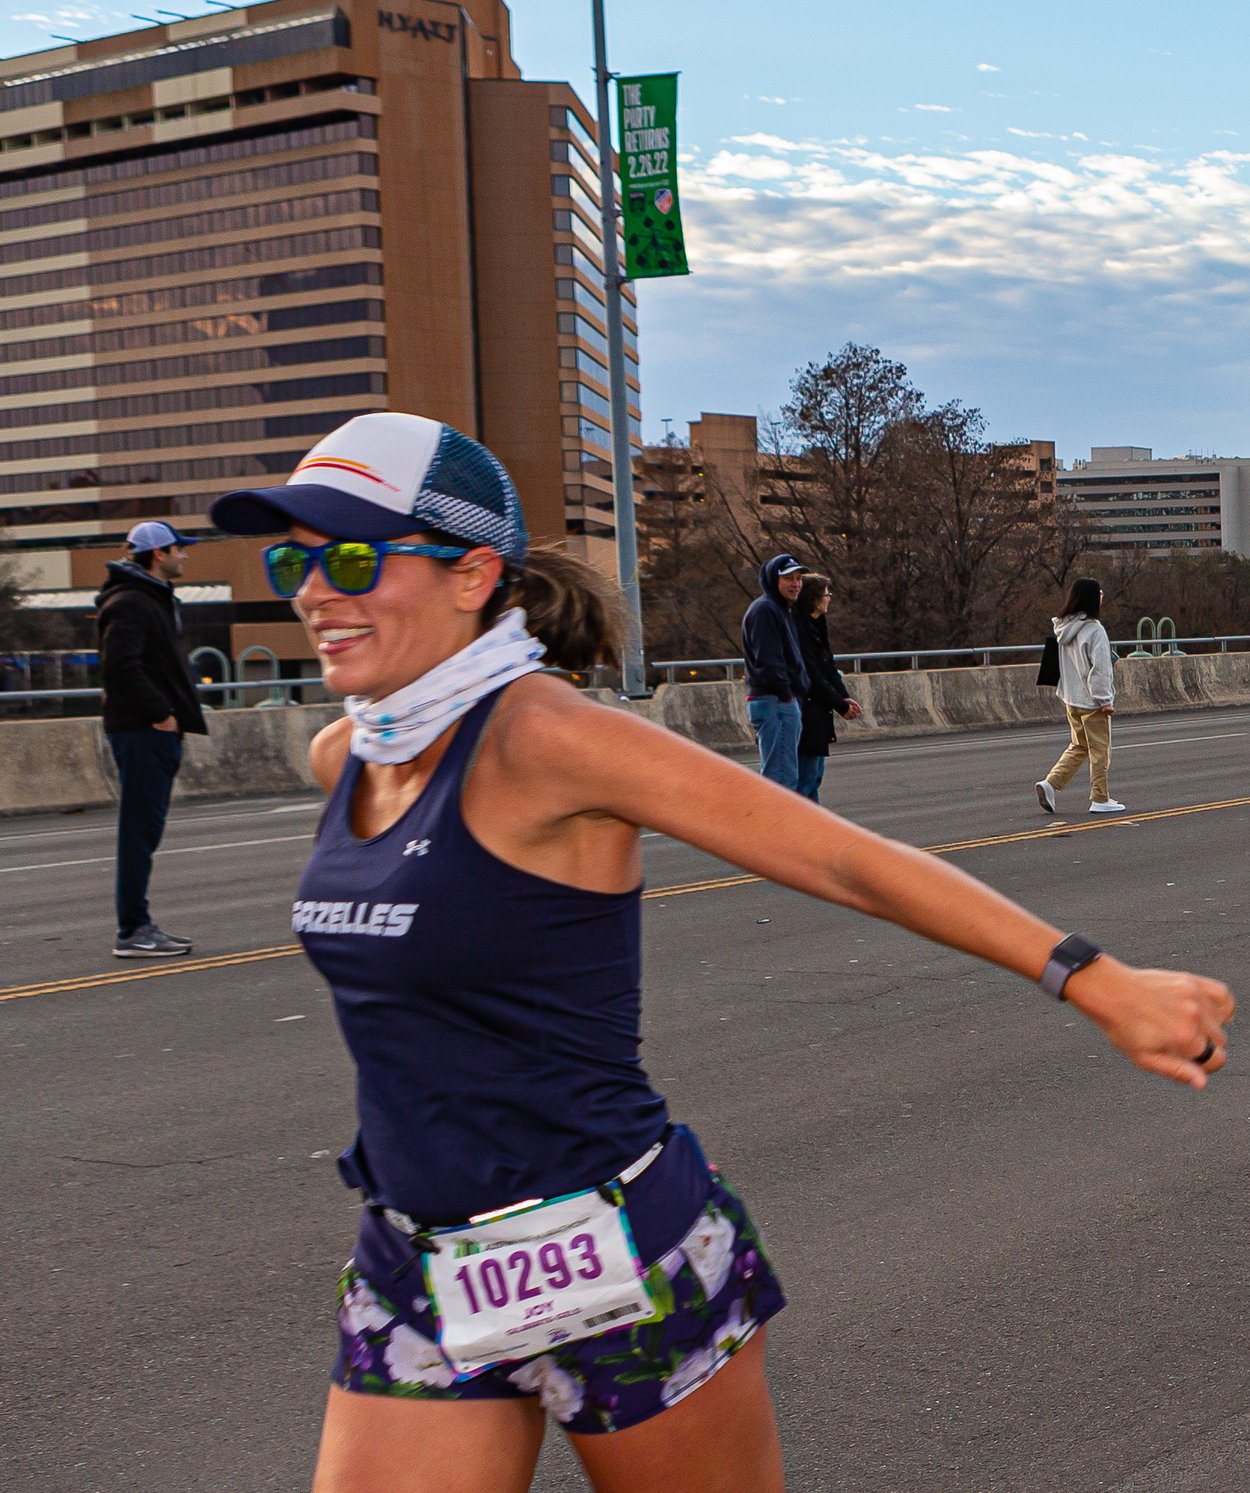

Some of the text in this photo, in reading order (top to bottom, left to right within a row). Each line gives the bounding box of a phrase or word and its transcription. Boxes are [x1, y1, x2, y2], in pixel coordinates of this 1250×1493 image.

[378, 9, 457, 43] HYATT
[622, 84, 642, 106] THE
[623, 105, 656, 130] PARTY
[625, 127, 669, 152] RETURNS
[627, 150, 669, 178] 2.26.22
[455, 1233, 602, 1314] 10293
[524, 1300, 554, 1319] JOY
